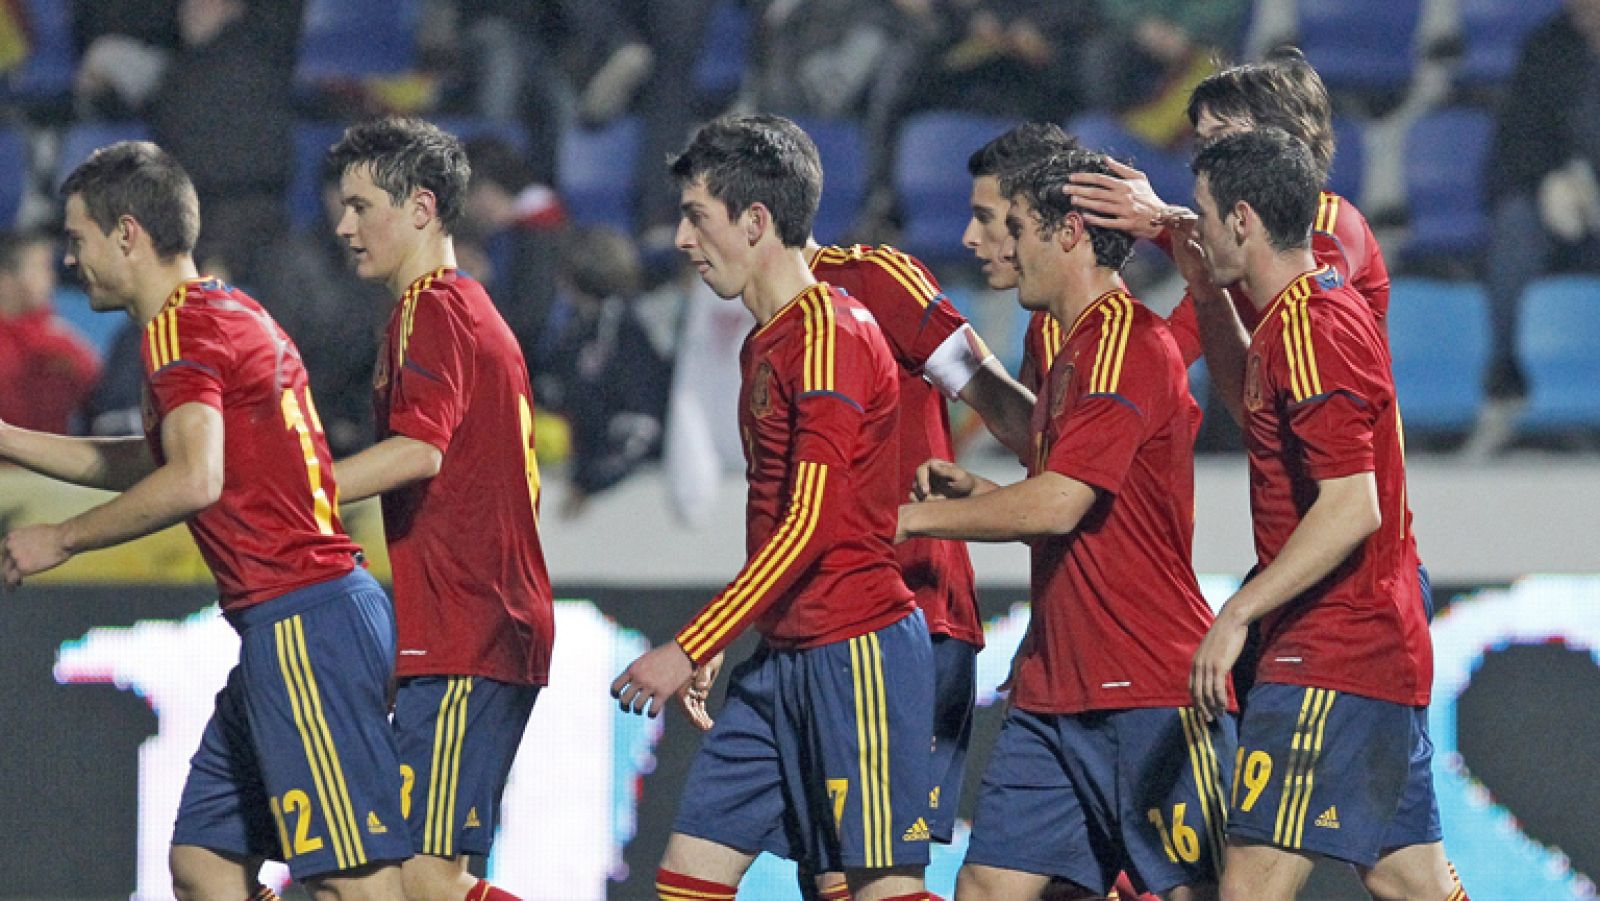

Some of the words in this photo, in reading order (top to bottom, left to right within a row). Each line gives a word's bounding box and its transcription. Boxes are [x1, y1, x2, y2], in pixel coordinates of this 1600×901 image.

[825, 777, 849, 835] 7
[1231, 746, 1272, 812] 19
[270, 788, 323, 860] 12
[1147, 803, 1200, 863] 16
